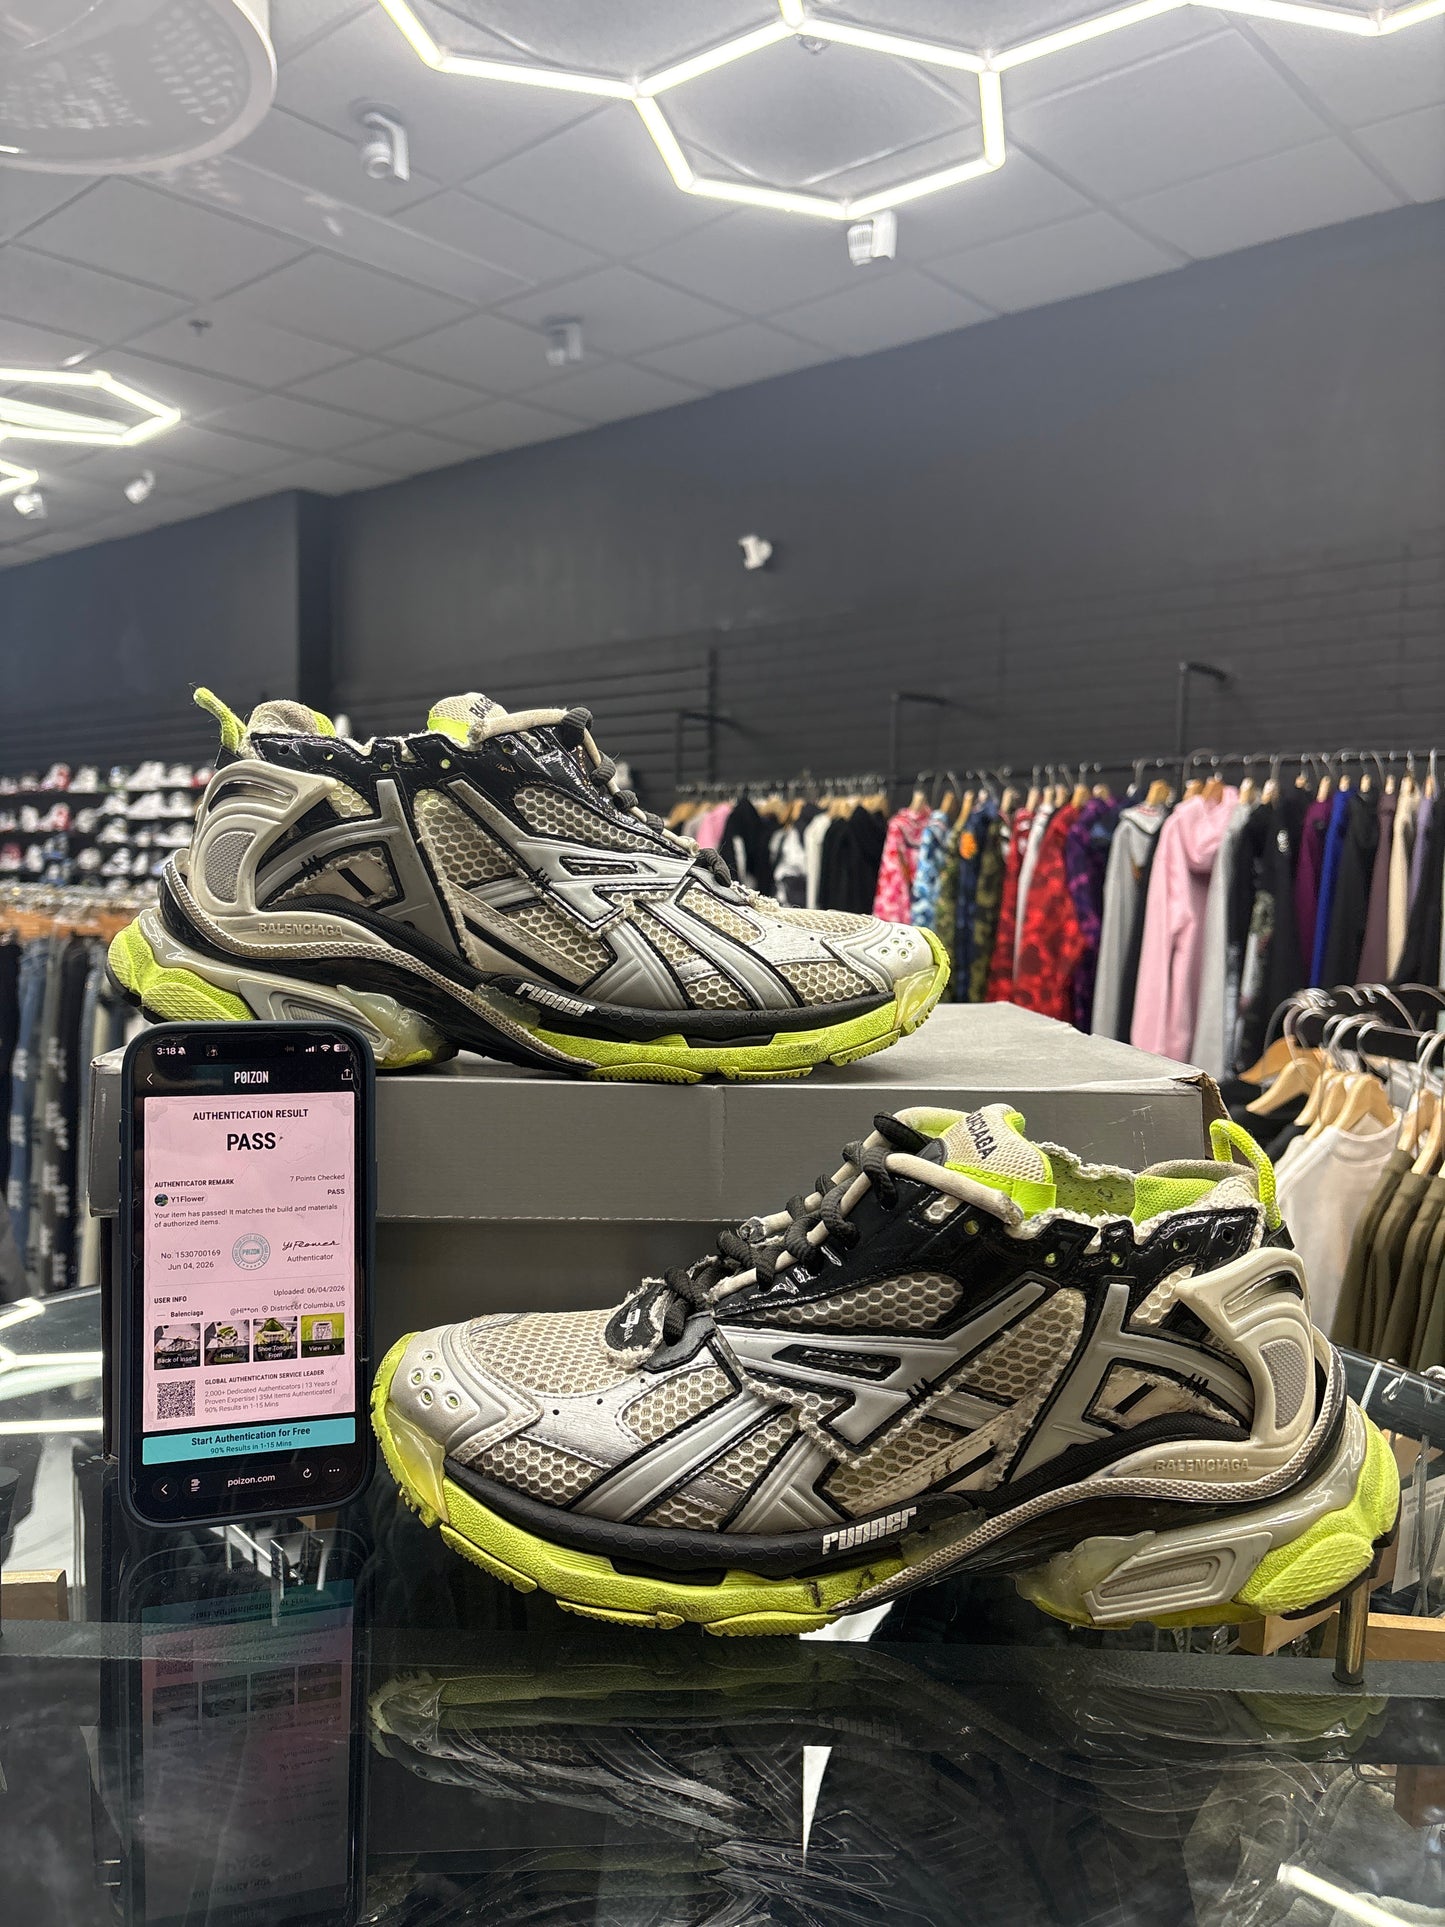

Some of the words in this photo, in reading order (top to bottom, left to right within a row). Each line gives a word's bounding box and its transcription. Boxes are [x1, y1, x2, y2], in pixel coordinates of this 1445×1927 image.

[258, 922, 344, 936] BALENCIAGA
[515, 982, 596, 1017] runner
[193, 1110, 273, 1120] AUTHENTICATION
[276, 1109, 308, 1118] RESULT
[227, 1132, 276, 1150] PASS
[176, 1250, 221, 1258] 1530700169
[287, 1254, 333, 1262] Authenticator
[274, 1288, 305, 1296] Uploaded:
[307, 1285, 345, 1294] 06/04/2026
[303, 1302, 334, 1310] Columbia,
[228, 1374, 278, 1383] AUTHENTICATION
[258, 1384, 300, 1392] Authenticators
[292, 1389, 332, 1397] Authenticated
[192, 1437, 212, 1446] Start
[215, 1431, 276, 1444] Authentication
[1154, 1458, 1249, 1472] BALENCIAGA
[227, 1474, 276, 1487] poizon.com
[822, 1506, 916, 1555] runner
